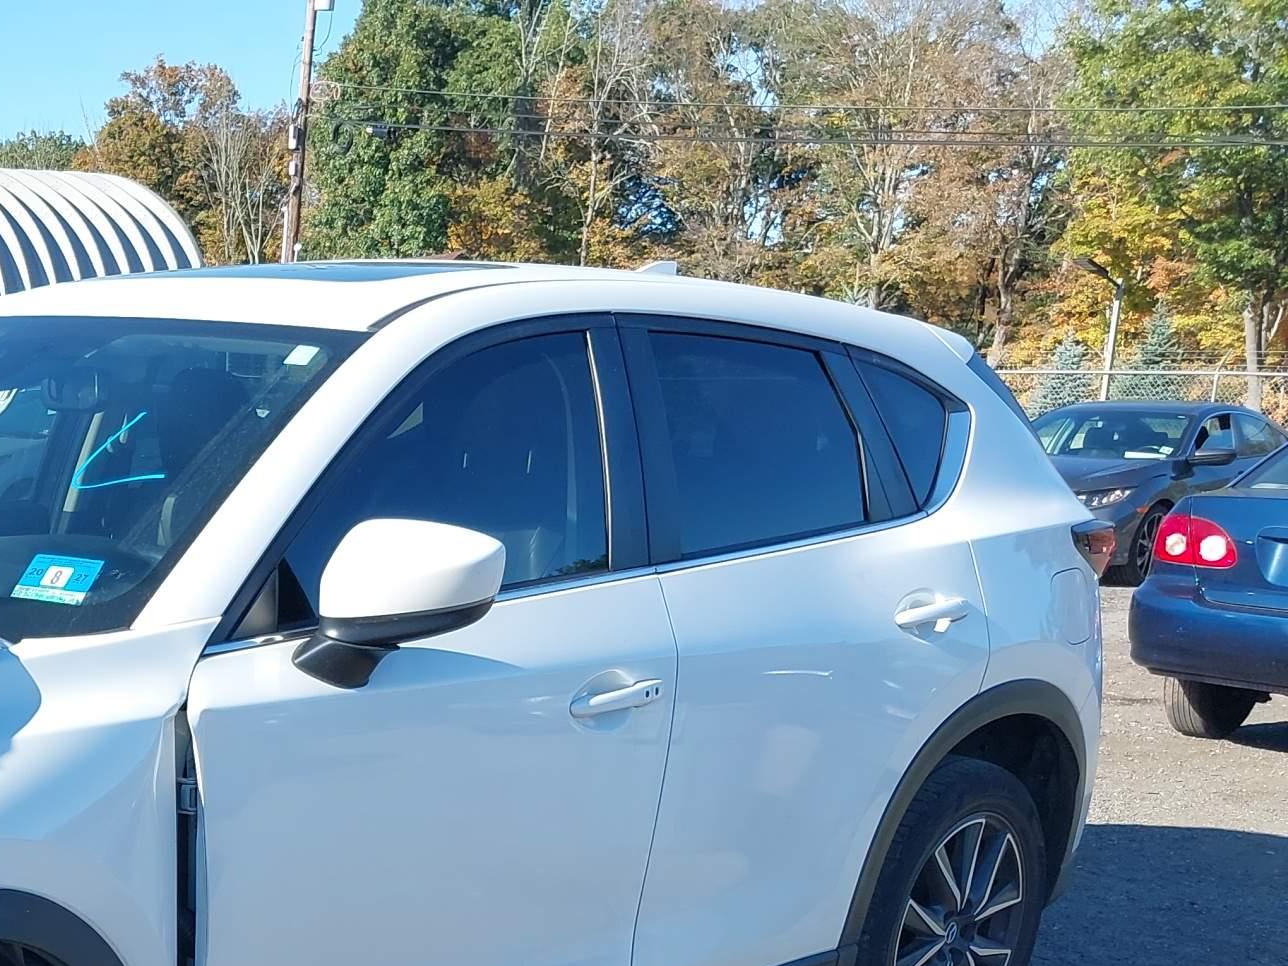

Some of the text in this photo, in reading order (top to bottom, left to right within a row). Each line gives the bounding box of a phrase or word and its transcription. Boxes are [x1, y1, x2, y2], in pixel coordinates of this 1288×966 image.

[28, 567, 89, 584] 20 8 27
